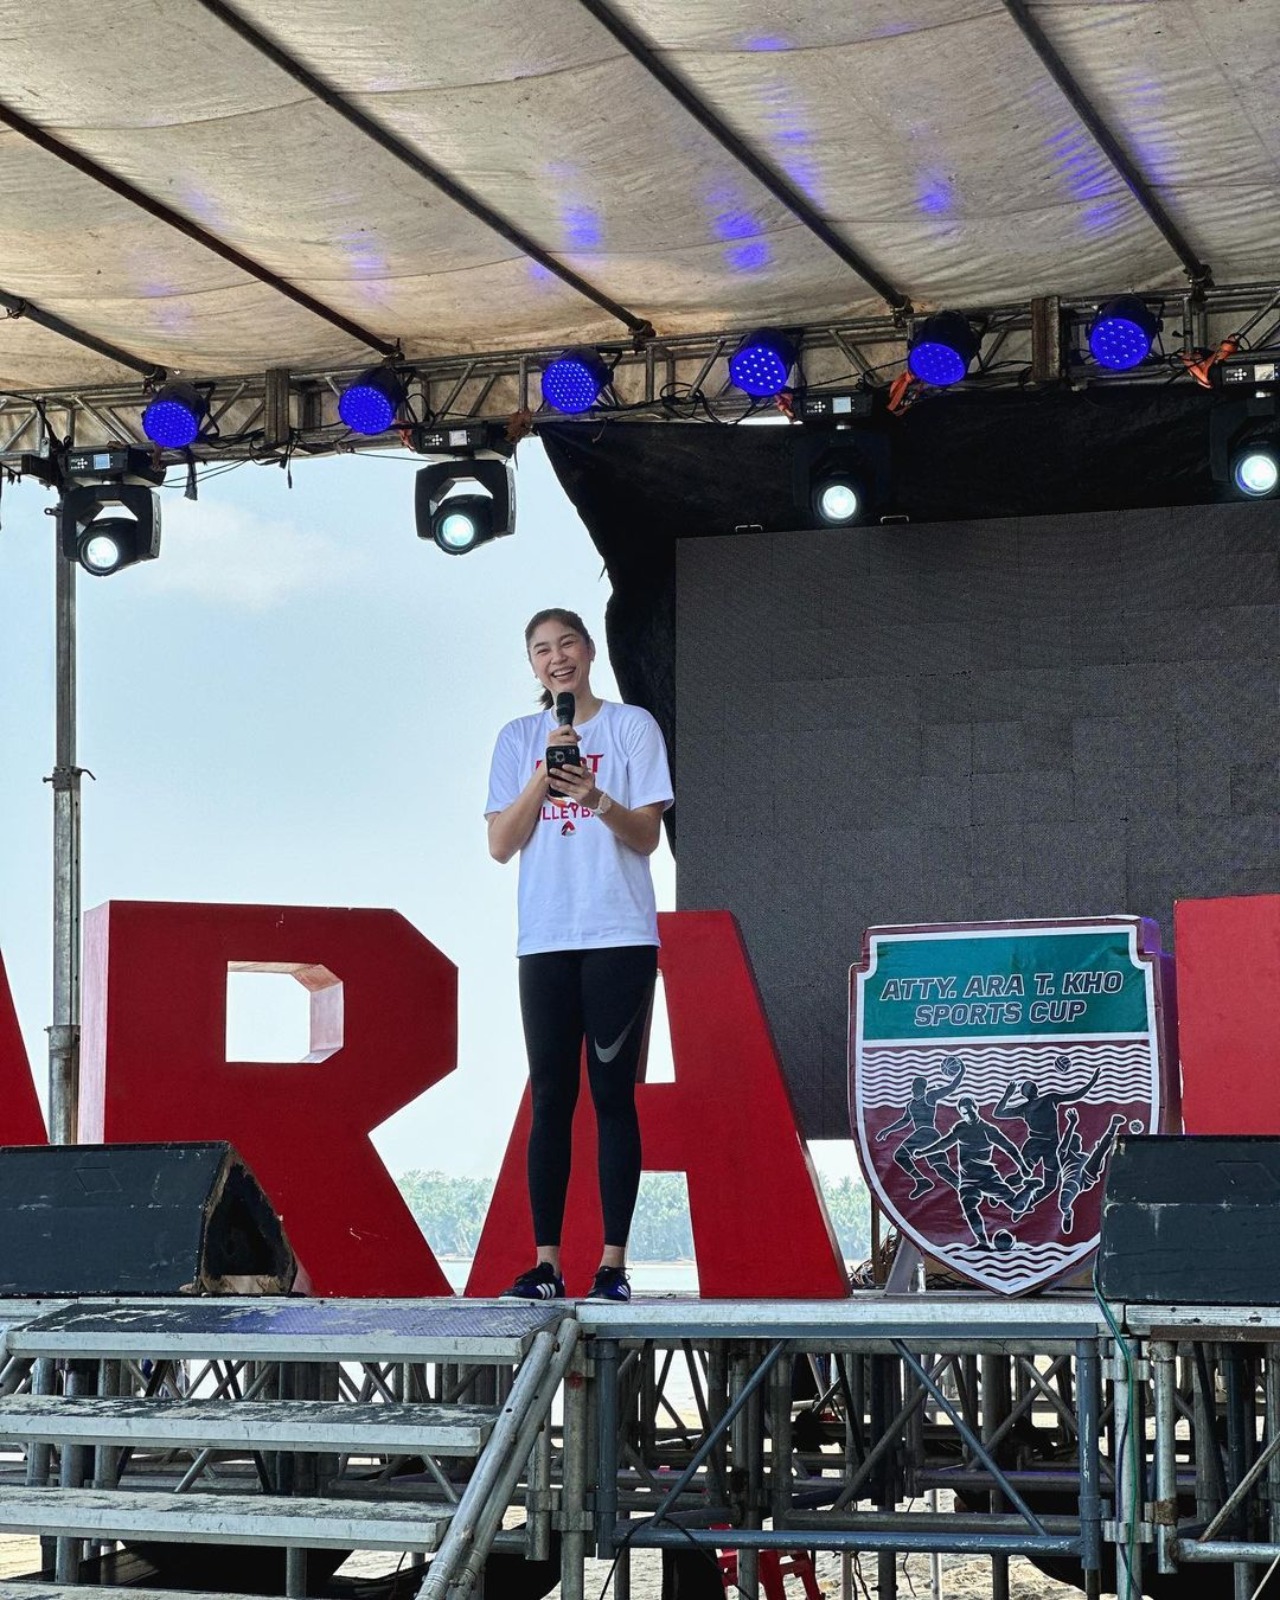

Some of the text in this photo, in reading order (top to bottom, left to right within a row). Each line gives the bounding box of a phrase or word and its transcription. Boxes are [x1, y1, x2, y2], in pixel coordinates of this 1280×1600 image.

[880, 970, 1124, 1001] ATTY. ARA T. KHO
[914, 999, 1087, 1027] SPORTS CUP
[0, 900, 850, 1299] RA
